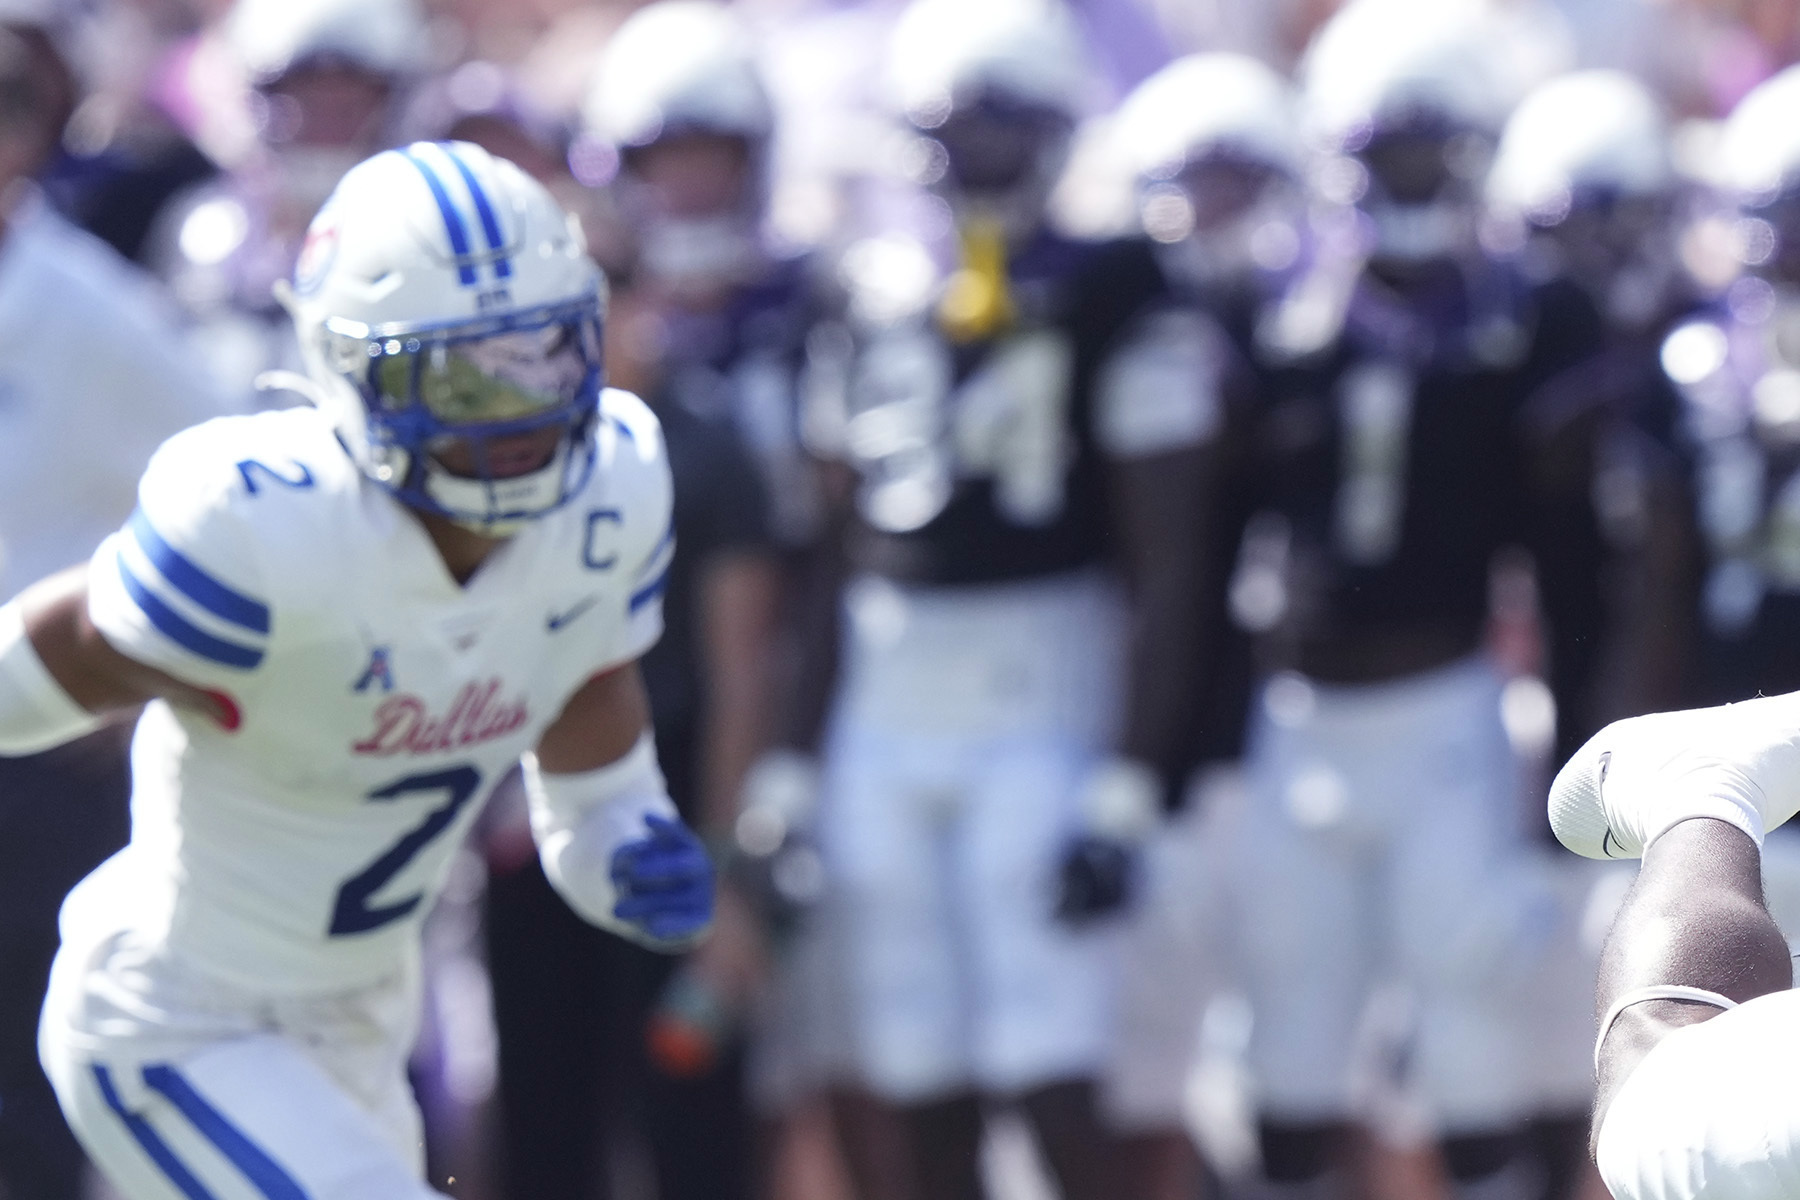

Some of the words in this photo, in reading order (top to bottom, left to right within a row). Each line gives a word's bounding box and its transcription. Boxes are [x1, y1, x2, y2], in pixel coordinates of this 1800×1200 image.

[236, 458, 314, 495] 2
[581, 509, 622, 570] C
[354, 676, 529, 757] Dallas
[328, 764, 482, 938] 2
